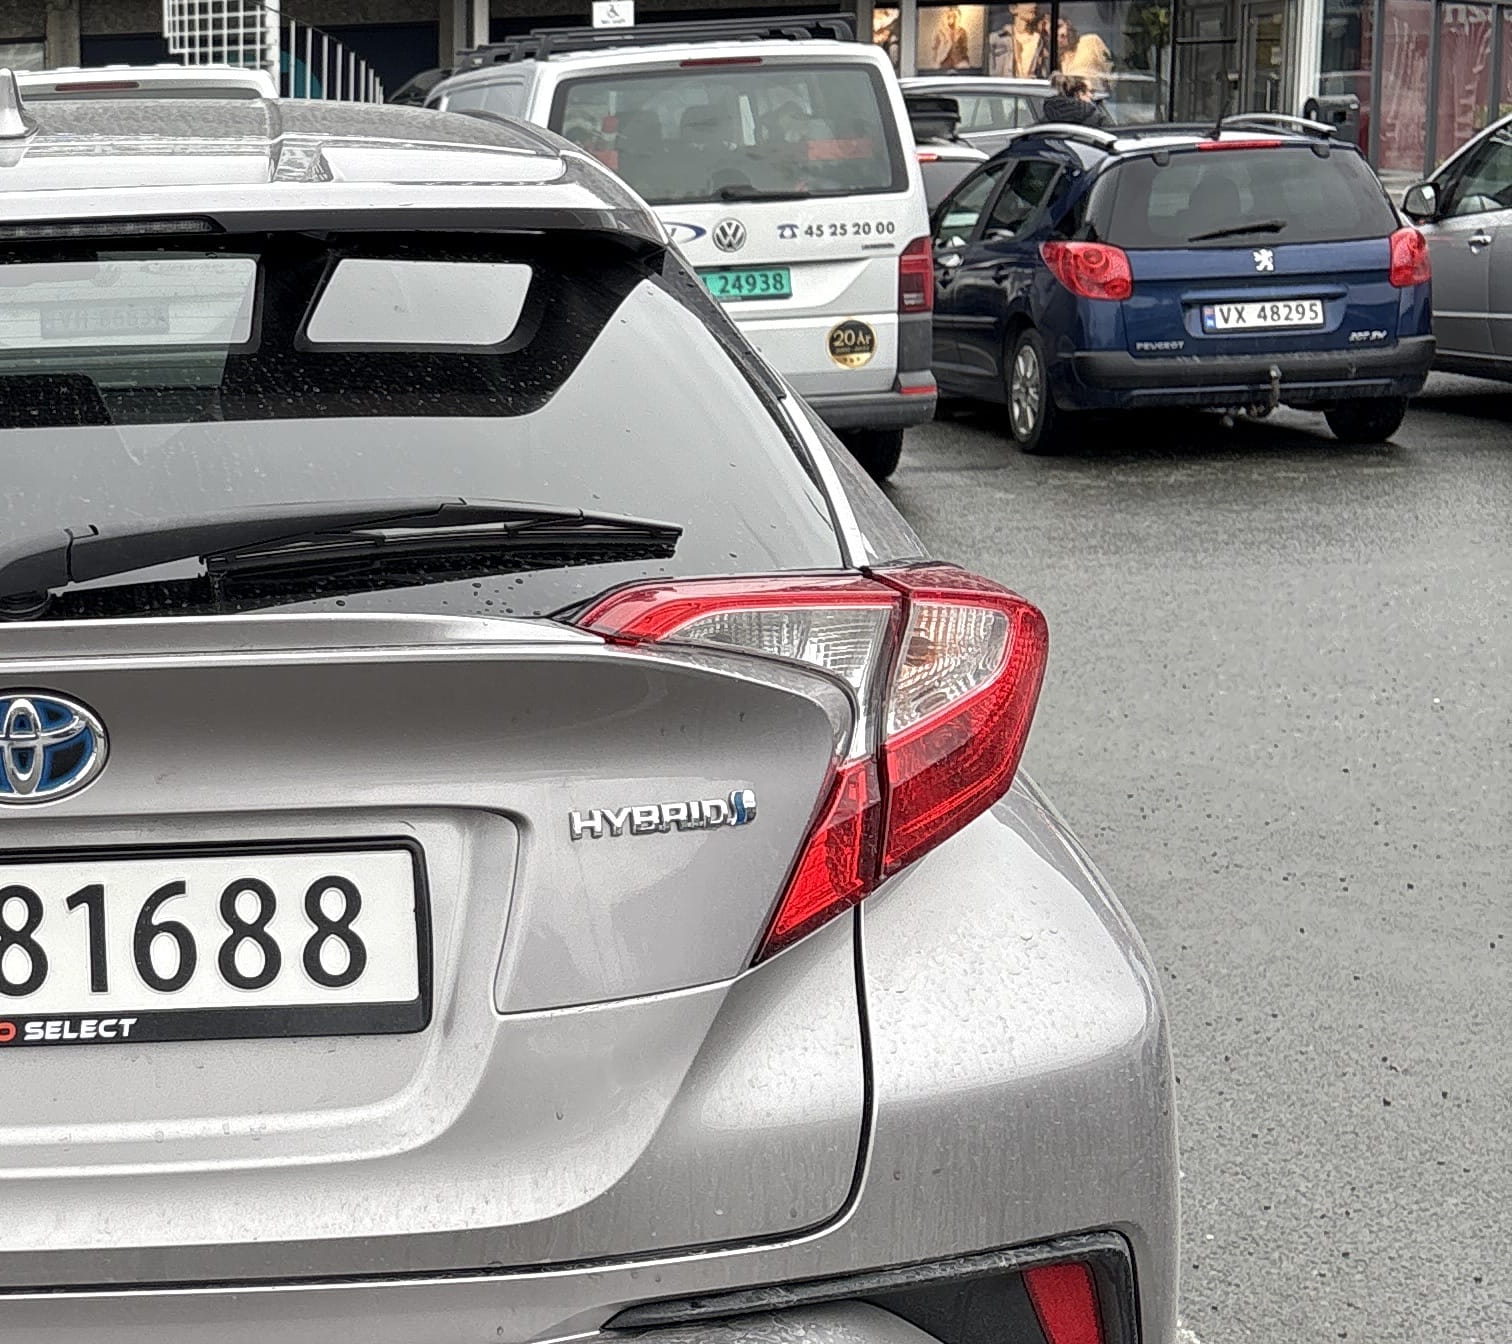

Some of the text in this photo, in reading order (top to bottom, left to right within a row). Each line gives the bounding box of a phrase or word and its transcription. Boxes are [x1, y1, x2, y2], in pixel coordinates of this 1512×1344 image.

[804, 221, 895, 237] 45 25 20 00
[718, 272, 785, 295] 24938
[1219, 306, 1246, 325] VX
[1257, 303, 1319, 323] 48295
[832, 329, 856, 347] 20
[569, 798, 728, 841] HYBRID
[23, 1016, 137, 1042] SELECT
